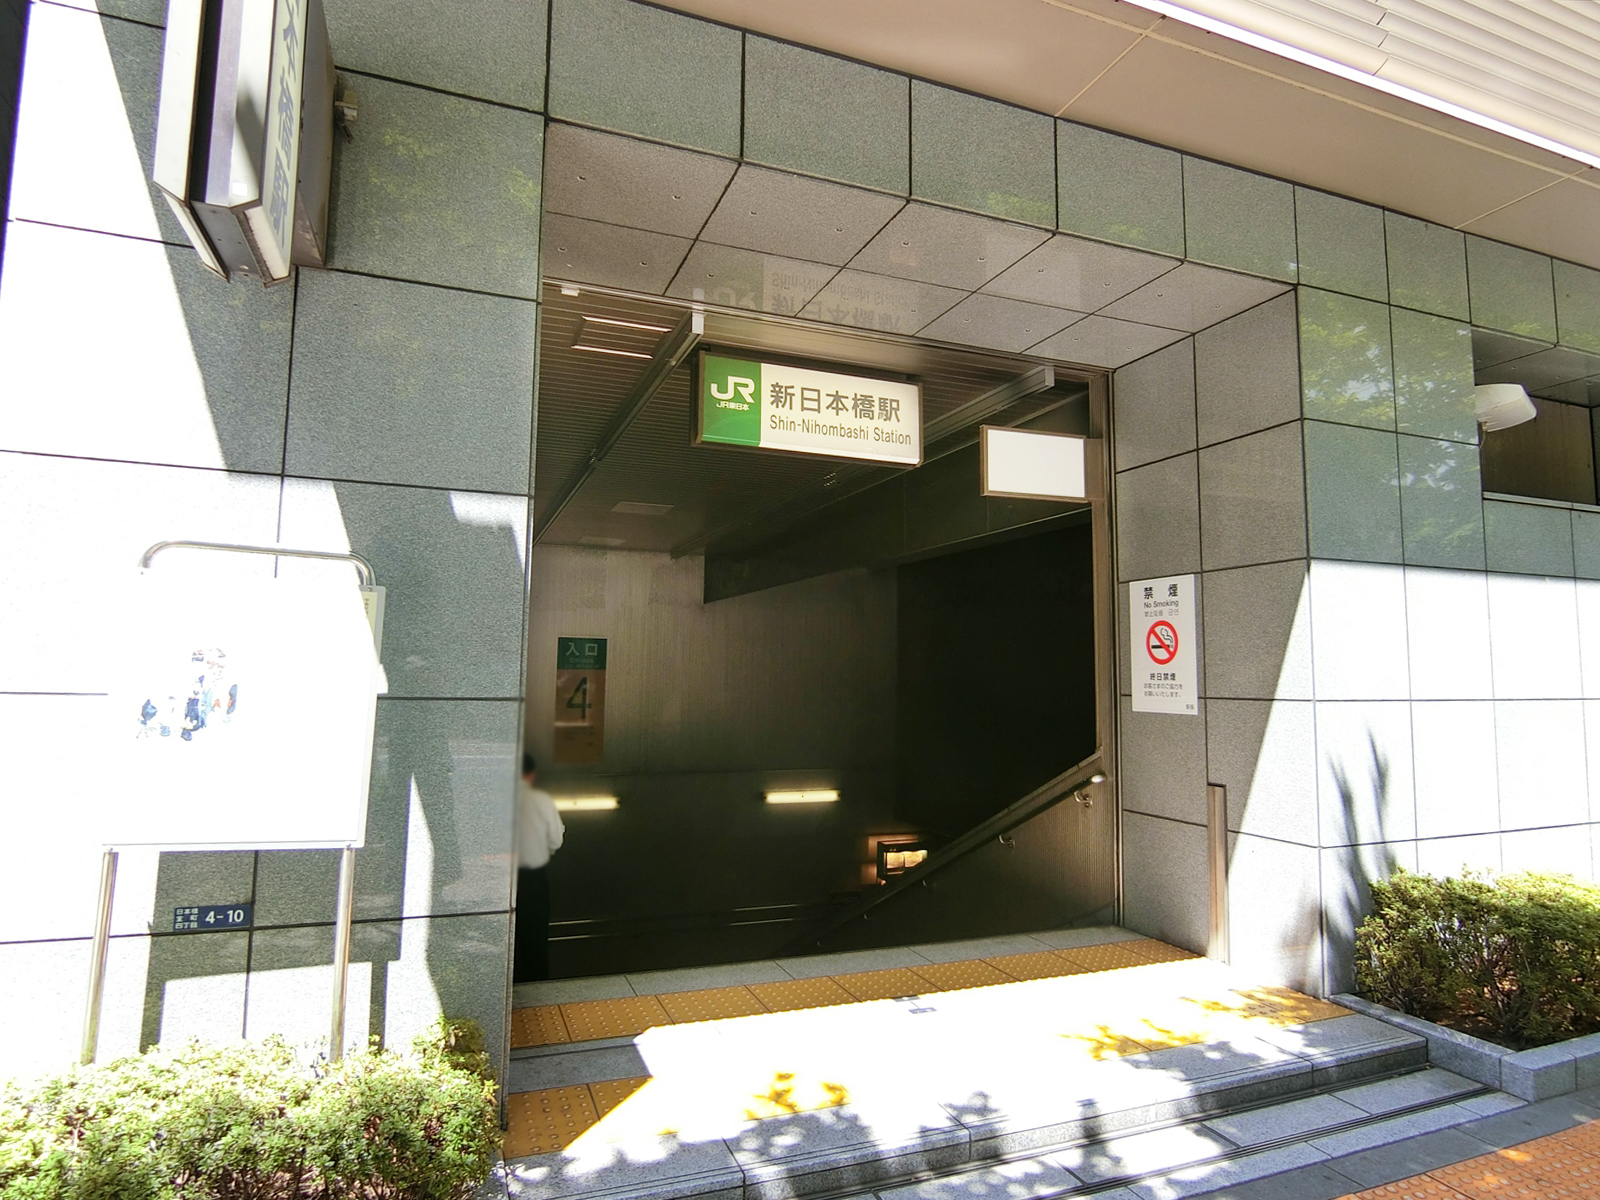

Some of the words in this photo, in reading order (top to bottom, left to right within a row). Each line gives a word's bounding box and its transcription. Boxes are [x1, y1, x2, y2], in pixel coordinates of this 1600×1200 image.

[270, 0, 300, 248] 本橋駅
[710, 375, 755, 403] JR
[716, 401, 750, 411] JR東日本
[770, 382, 901, 423] 新日本橋駅
[770, 414, 869, 441] Shin-Nihombashi
[873, 428, 912, 446] Station
[1143, 583, 1178, 600] 禁煙
[1144, 601, 1152, 609] No
[1153, 600, 1179, 608] Smoking
[565, 642, 598, 656] 入口
[1150, 673, 1176, 681] 終日禁煙
[566, 676, 592, 720] 4
[205, 909, 244, 924] 4-10
